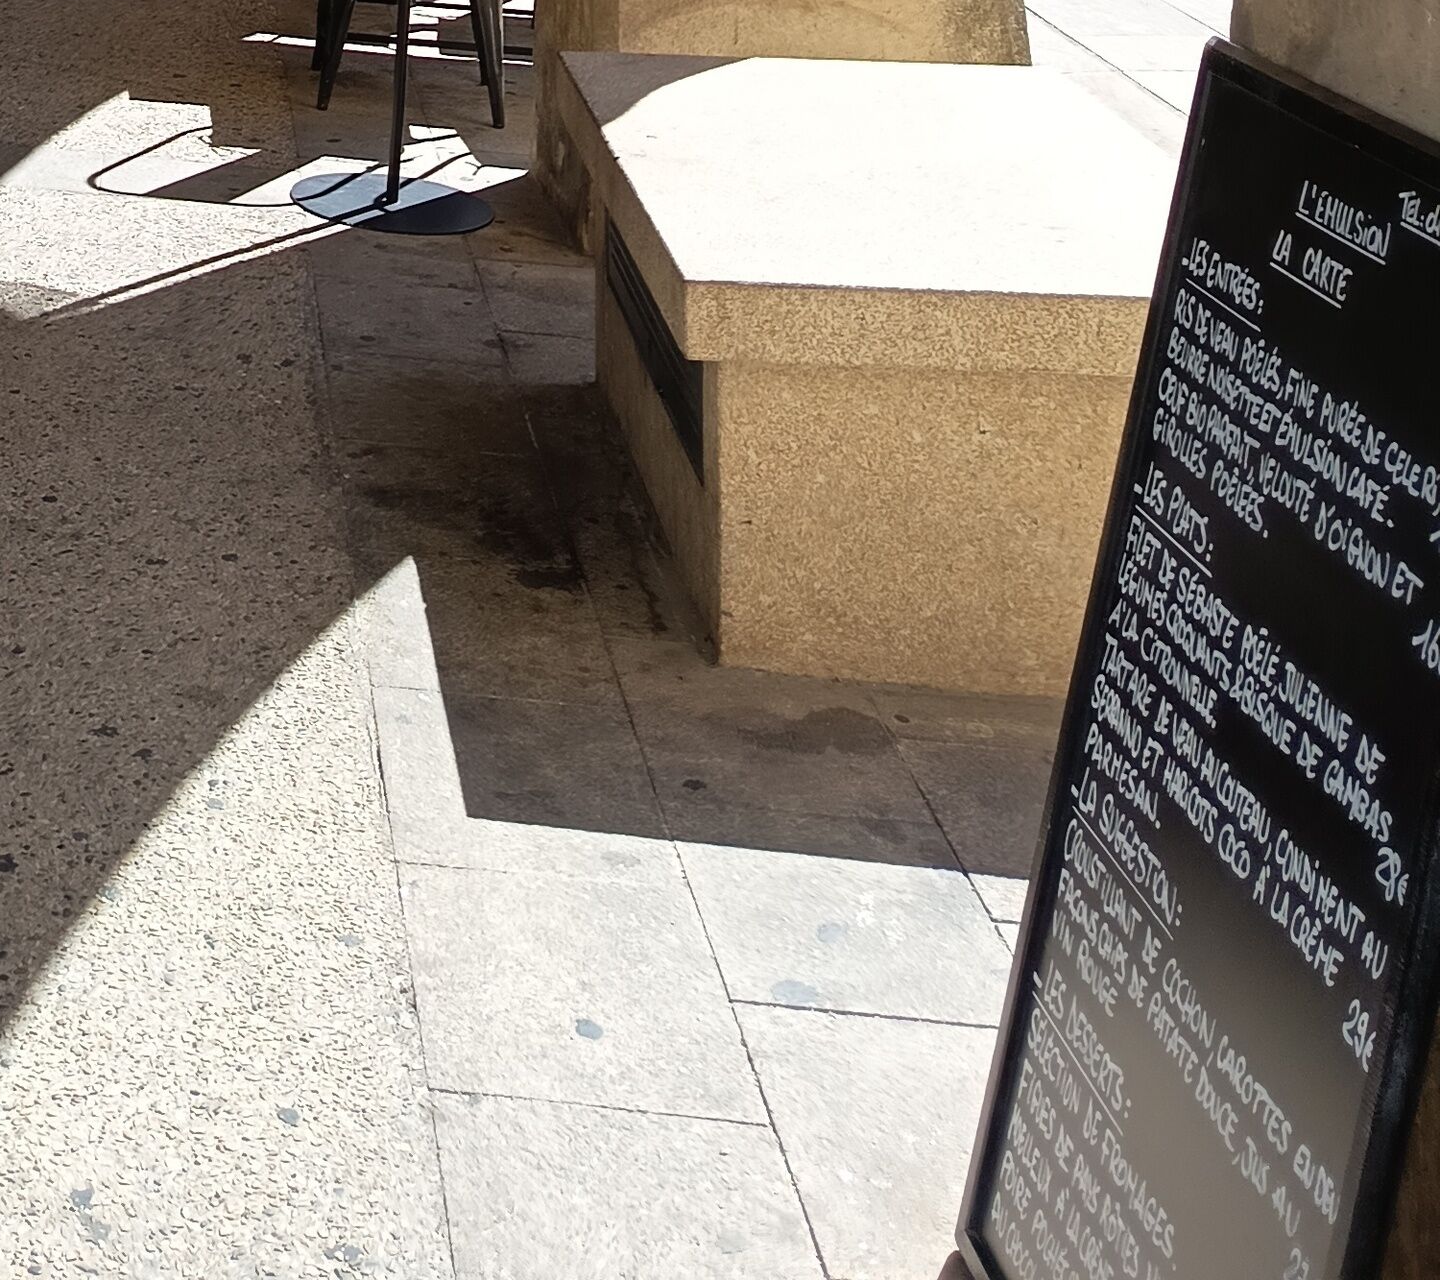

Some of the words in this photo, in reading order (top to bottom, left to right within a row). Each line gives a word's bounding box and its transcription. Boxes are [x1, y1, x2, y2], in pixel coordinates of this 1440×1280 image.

[1272, 230, 1292, 266] LA
[1302, 247, 1353, 301] CARTE
[1167, 327, 1210, 384] BEURRE
[1258, 402, 1282, 432] ET
[1346, 467, 1394, 528] CAFÉ.
[1195, 303, 1211, 344] DE
[1210, 317, 1239, 362] VEAU
[1319, 392, 1366, 447] PURÉE
[1360, 425, 1386, 465] DE
[1167, 486, 1213, 562] PLATS:
[1259, 452, 1316, 523] VELOUTÉ
[1392, 561, 1424, 605] ET
[1158, 548, 1177, 591] DE
[1176, 567, 1240, 649] SÉBASTE
[1354, 733, 1386, 785] DE
[1412, 618, 1440, 676] 16
[1084, 722, 1161, 830] PARMESAN.
[1100, 632, 1158, 718] TARTARE
[1154, 695, 1174, 735] DE
[1172, 711, 1204, 769] VEAU
[1361, 930, 1388, 980] AU
[1296, 731, 1324, 779] DE
[1323, 759, 1393, 843] GAMBAS
[1142, 736, 1164, 778] ET
[1271, 882, 1290, 928] LA
[1290, 904, 1344, 987] CRÈME
[1128, 963, 1148, 1008] DE
[1146, 991, 1199, 1084] PATATE
[1142, 926, 1162, 974] DE
[1217, 1035, 1292, 1154] CAROTTES
[1083, 1097, 1102, 1146] DE
